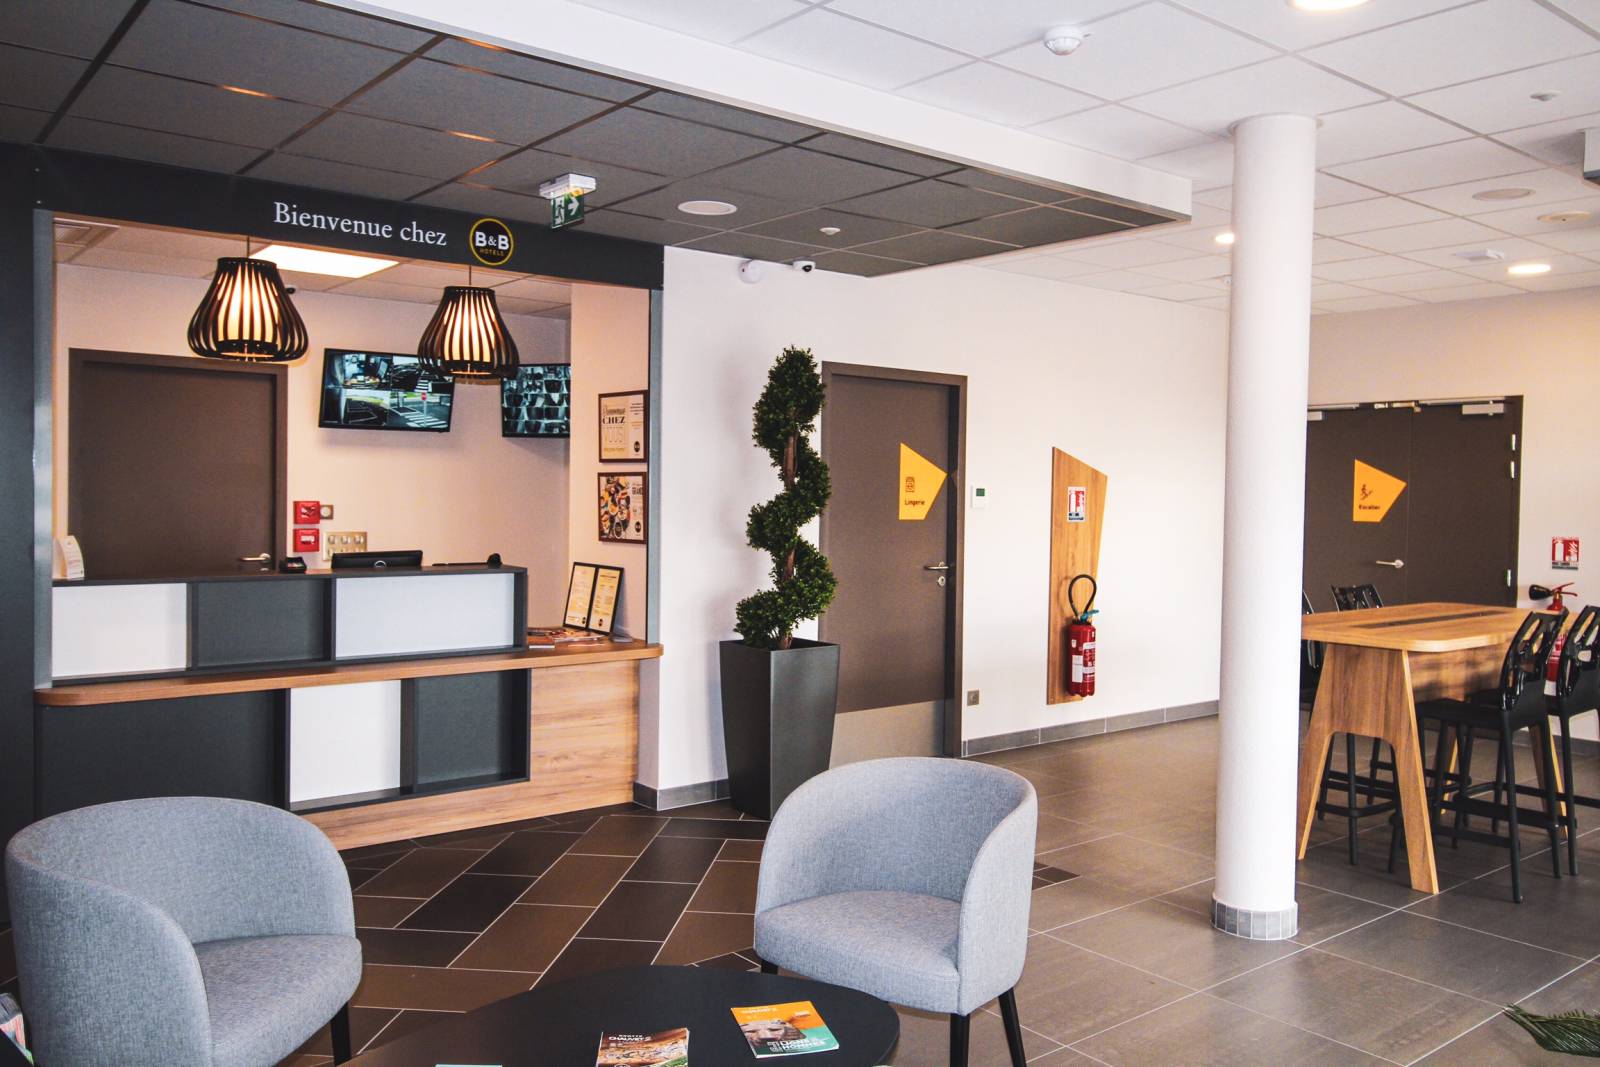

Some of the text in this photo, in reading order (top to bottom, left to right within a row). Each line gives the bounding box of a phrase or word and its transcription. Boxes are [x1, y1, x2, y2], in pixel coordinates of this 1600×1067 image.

[273, 201, 447, 246] Bienvenue chez
[475, 231, 510, 250] B&B
[479, 248, 505, 257] HOTELS
[904, 499, 925, 507] Lingerie
